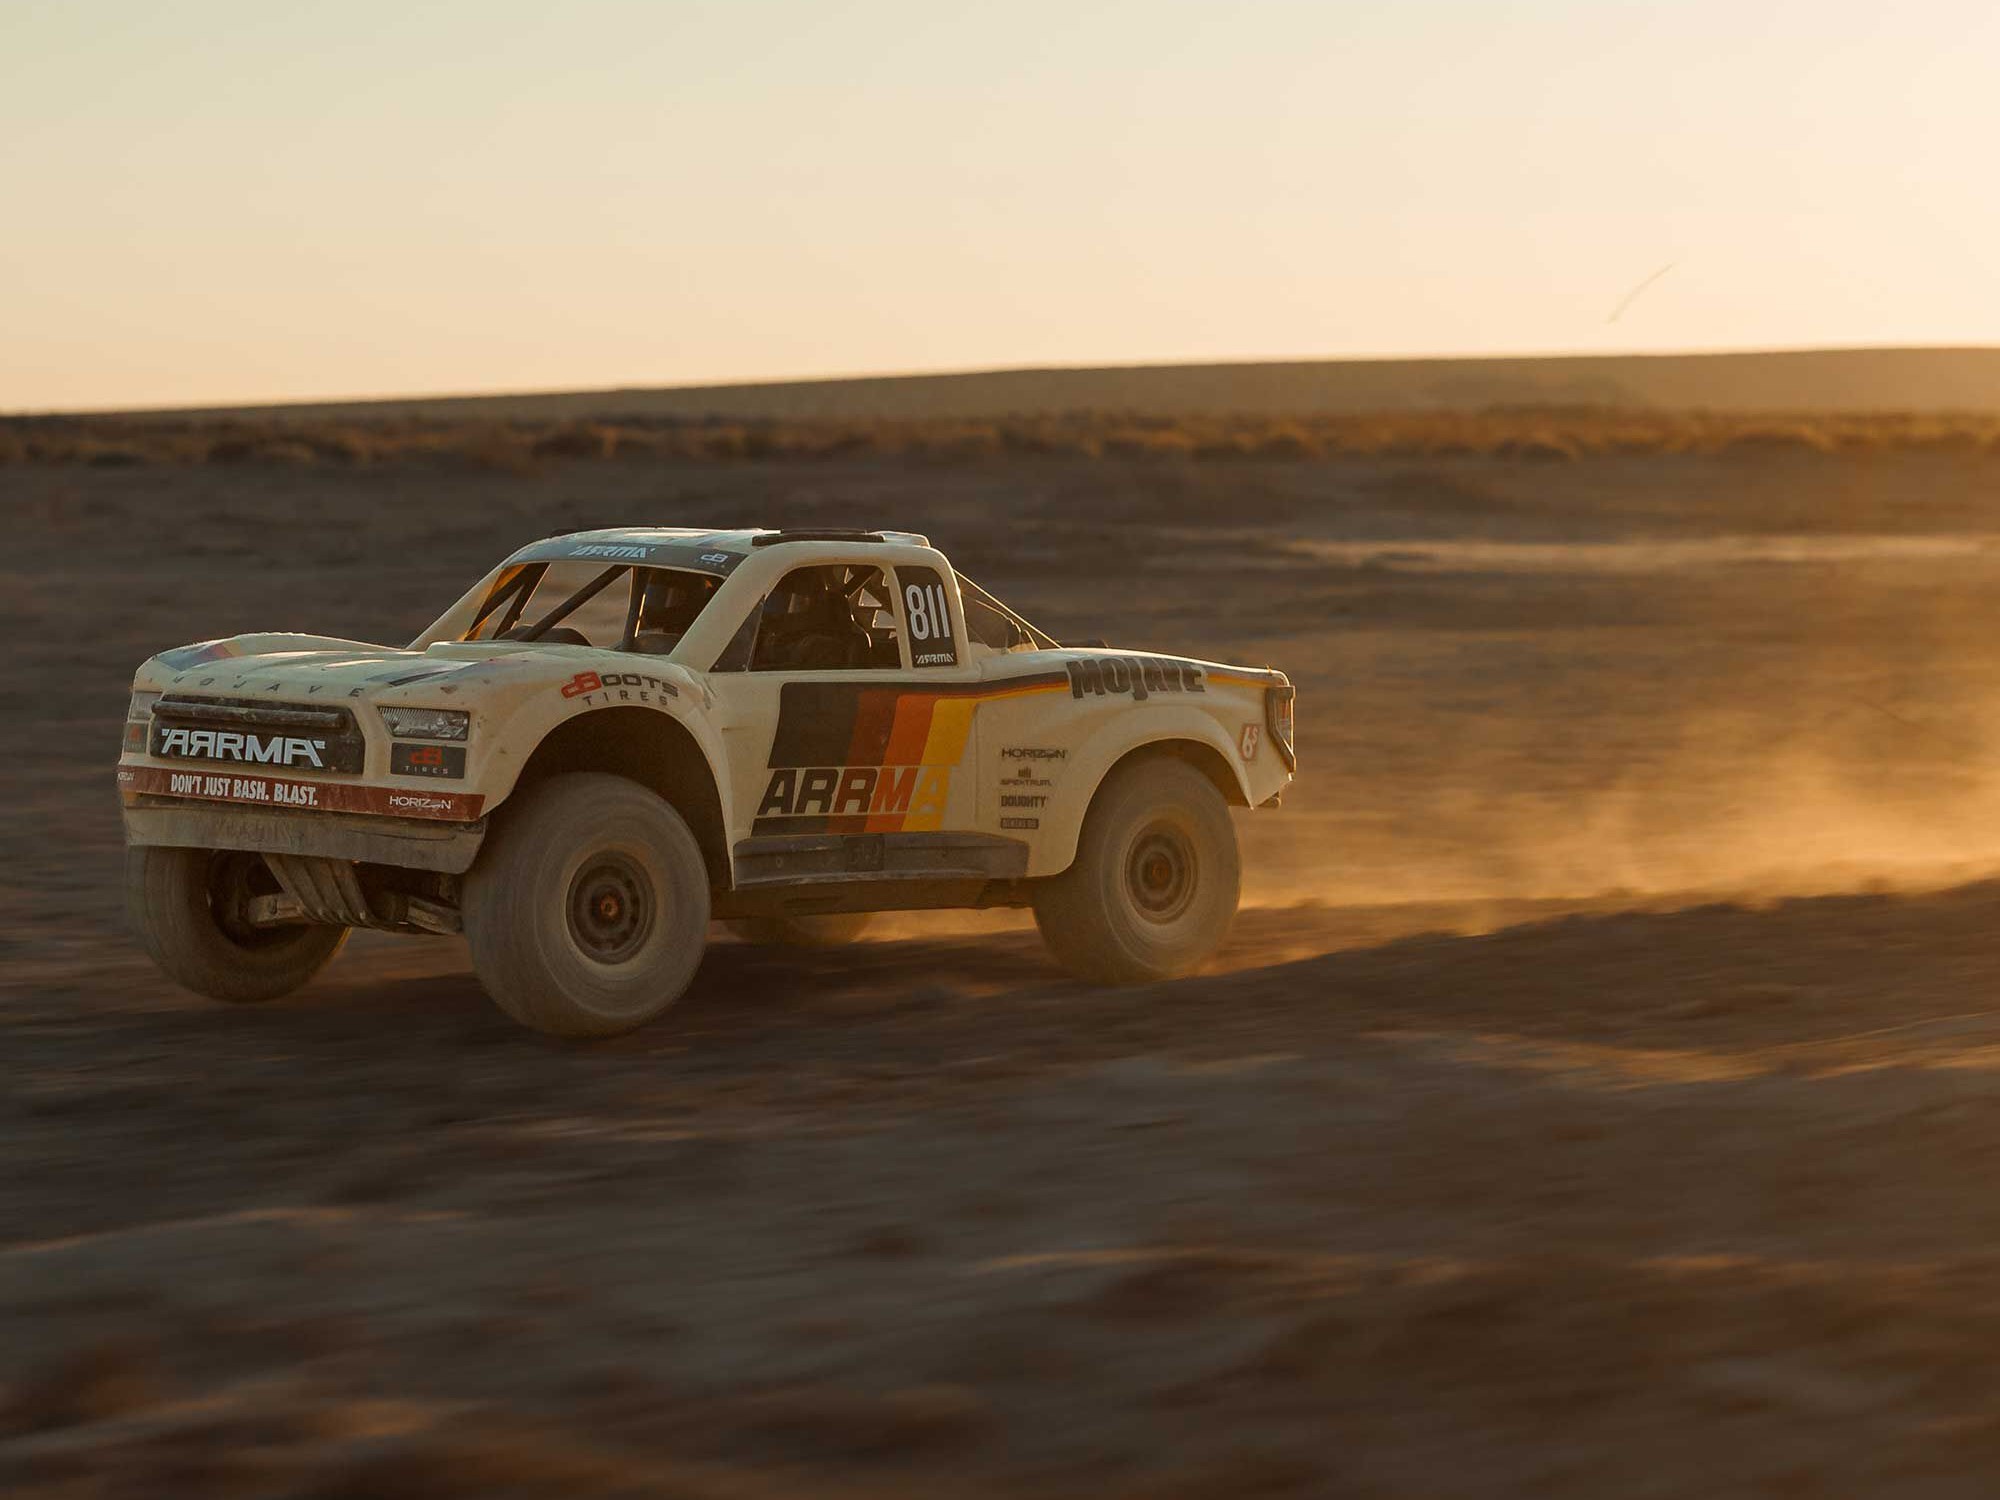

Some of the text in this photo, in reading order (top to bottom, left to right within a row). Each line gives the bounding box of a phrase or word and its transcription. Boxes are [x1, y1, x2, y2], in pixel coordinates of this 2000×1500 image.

[906, 584, 950, 640] 811
[583, 690, 668, 706] TIRES
[1066, 658, 1206, 700] MOJAVE
[161, 728, 326, 767] ARRMA
[405, 765, 449, 774] TIRES
[171, 774, 319, 806] DON'T JUST BASH. BLAST.
[757, 767, 950, 816] ARRMA
